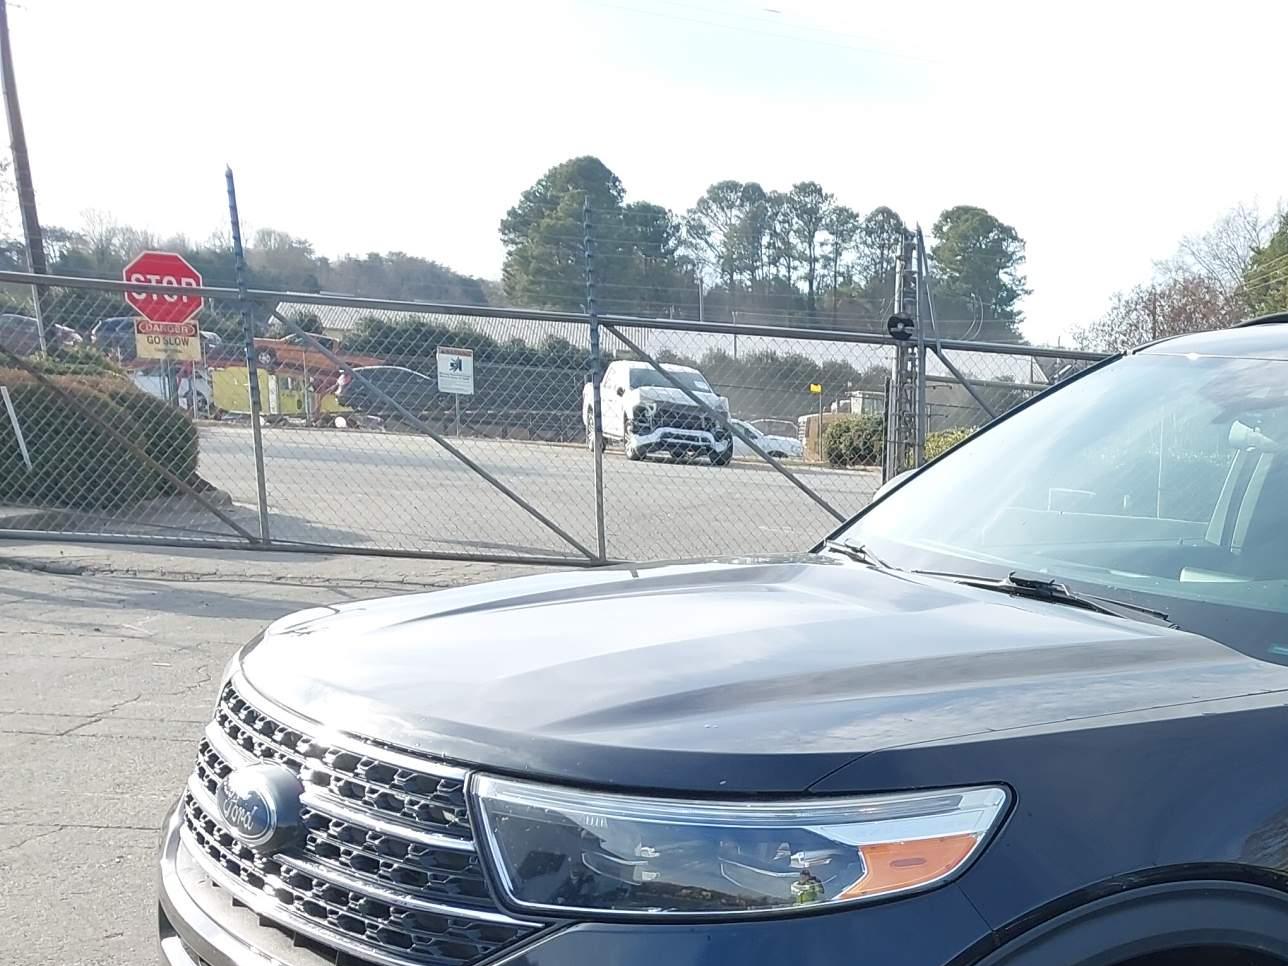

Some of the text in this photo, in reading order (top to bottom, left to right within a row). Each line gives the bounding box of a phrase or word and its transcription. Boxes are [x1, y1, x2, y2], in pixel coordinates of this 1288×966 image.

[131, 273, 197, 303] STOP
[146, 336, 190, 347] GO SLOW
[223, 795, 259, 831] Ford
